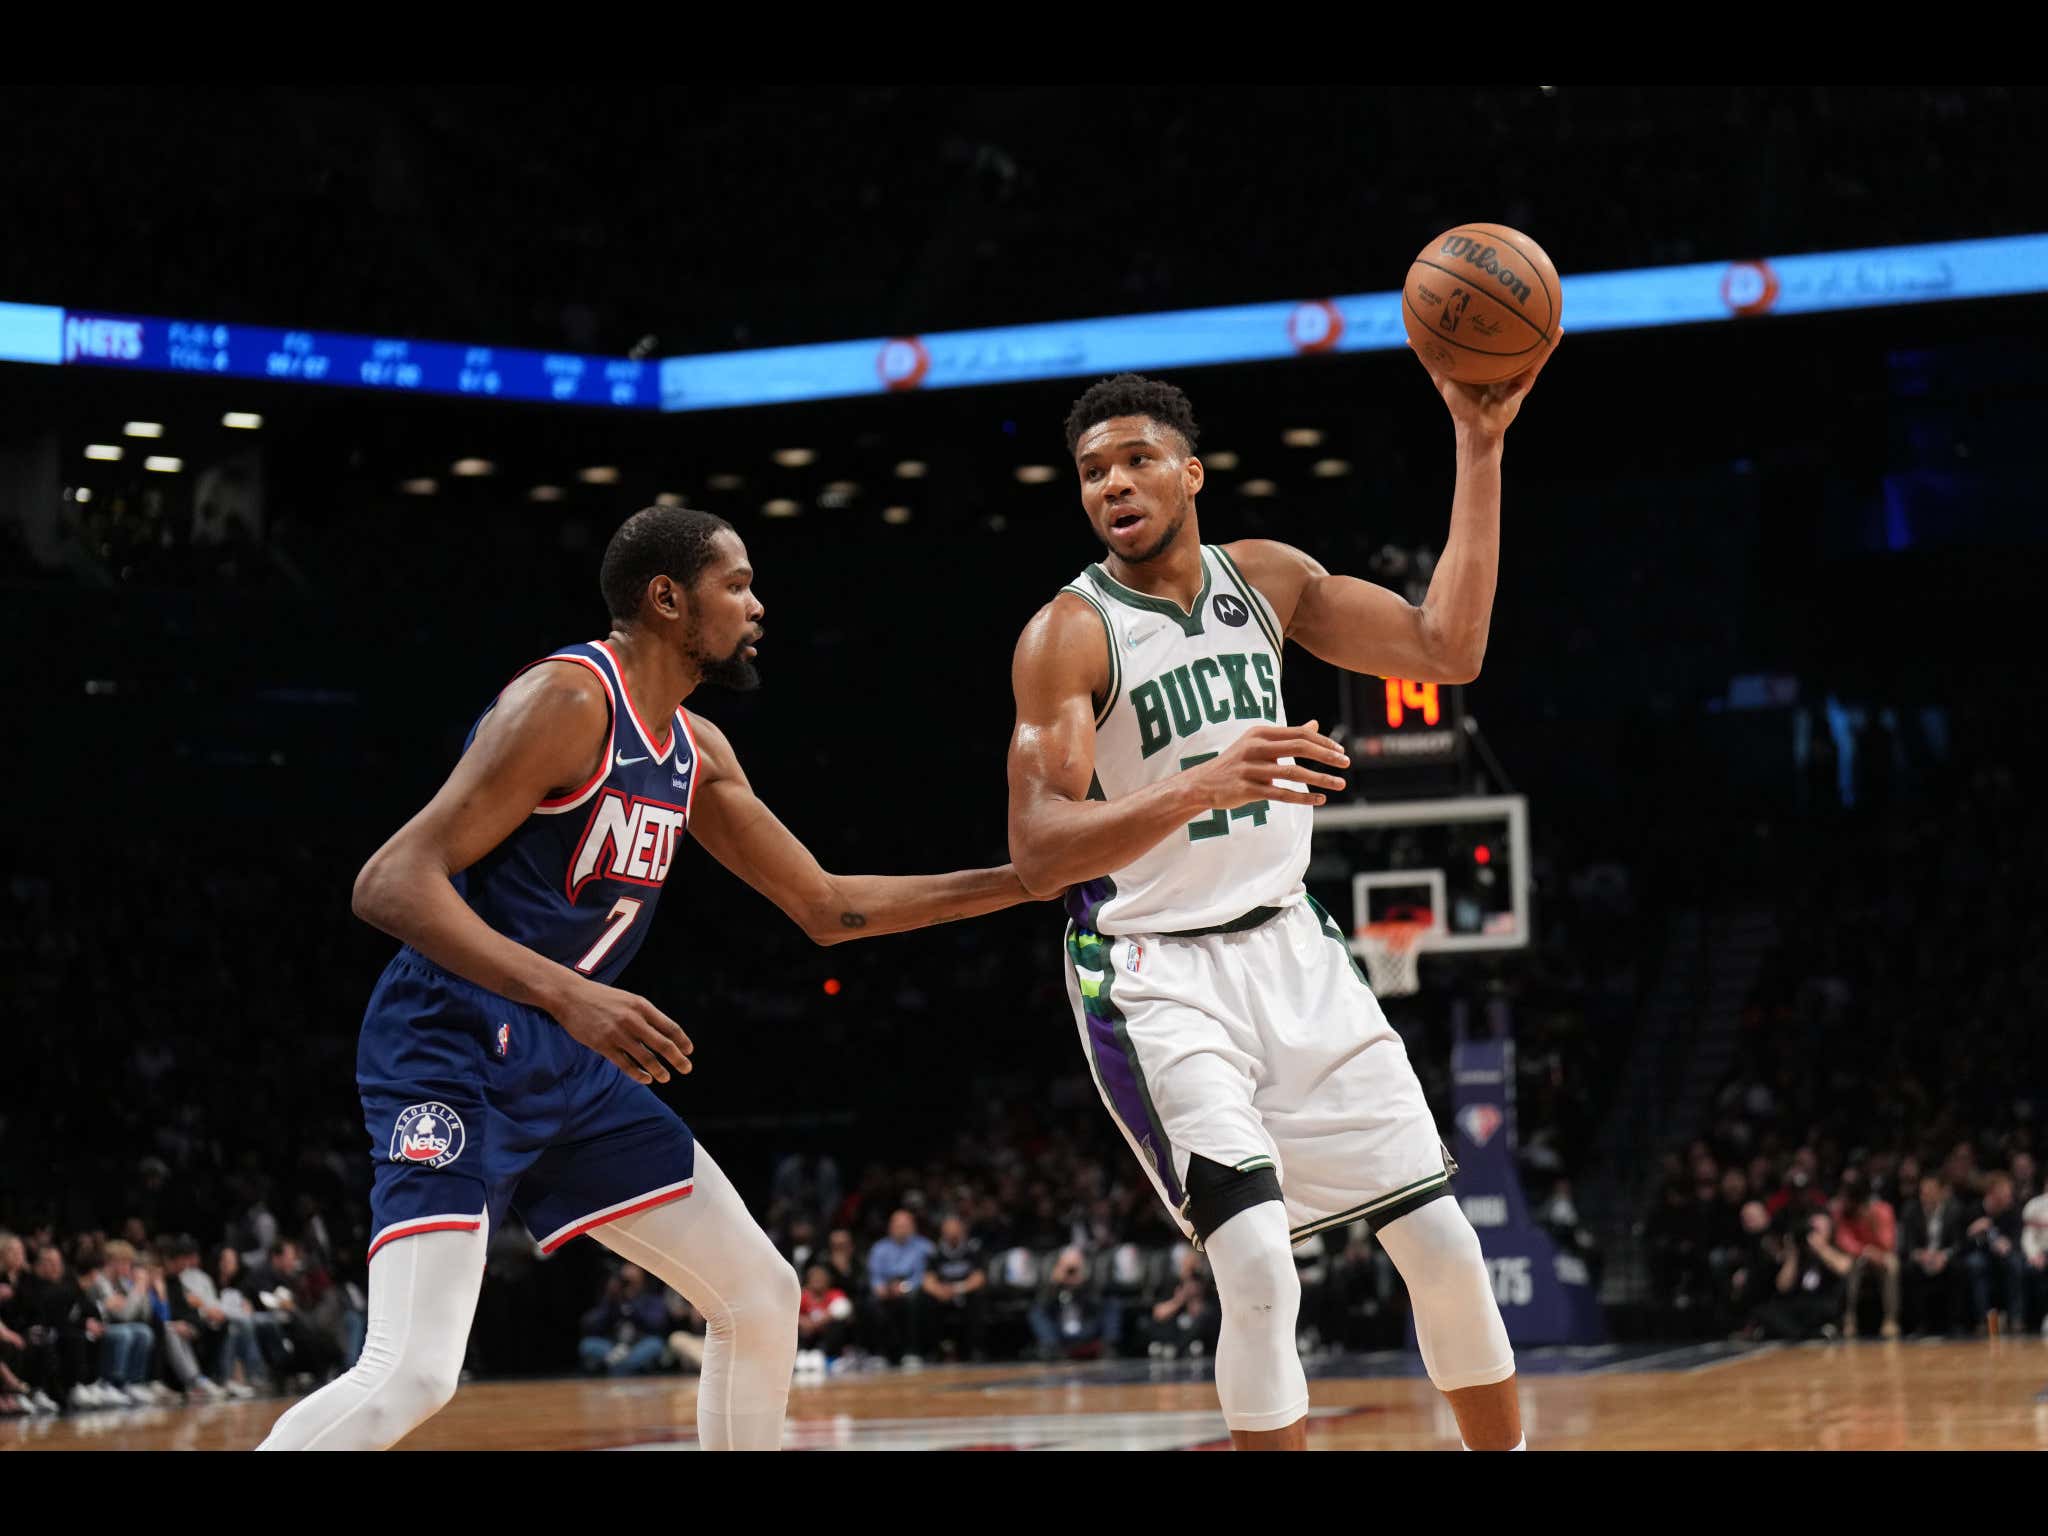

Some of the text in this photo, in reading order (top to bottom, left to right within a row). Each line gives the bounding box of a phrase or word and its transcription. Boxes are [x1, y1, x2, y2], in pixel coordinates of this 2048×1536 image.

[1440, 235, 1532, 305] Wilson
[65, 316, 144, 362] NETS
[1129, 651, 1278, 759] BUCKS
[1381, 676, 1440, 728] 14
[569, 790, 686, 899] NETS
[575, 897, 643, 974] 7
[397, 1104, 460, 1131] BROOKLYN
[403, 1133, 447, 1152] Nets
